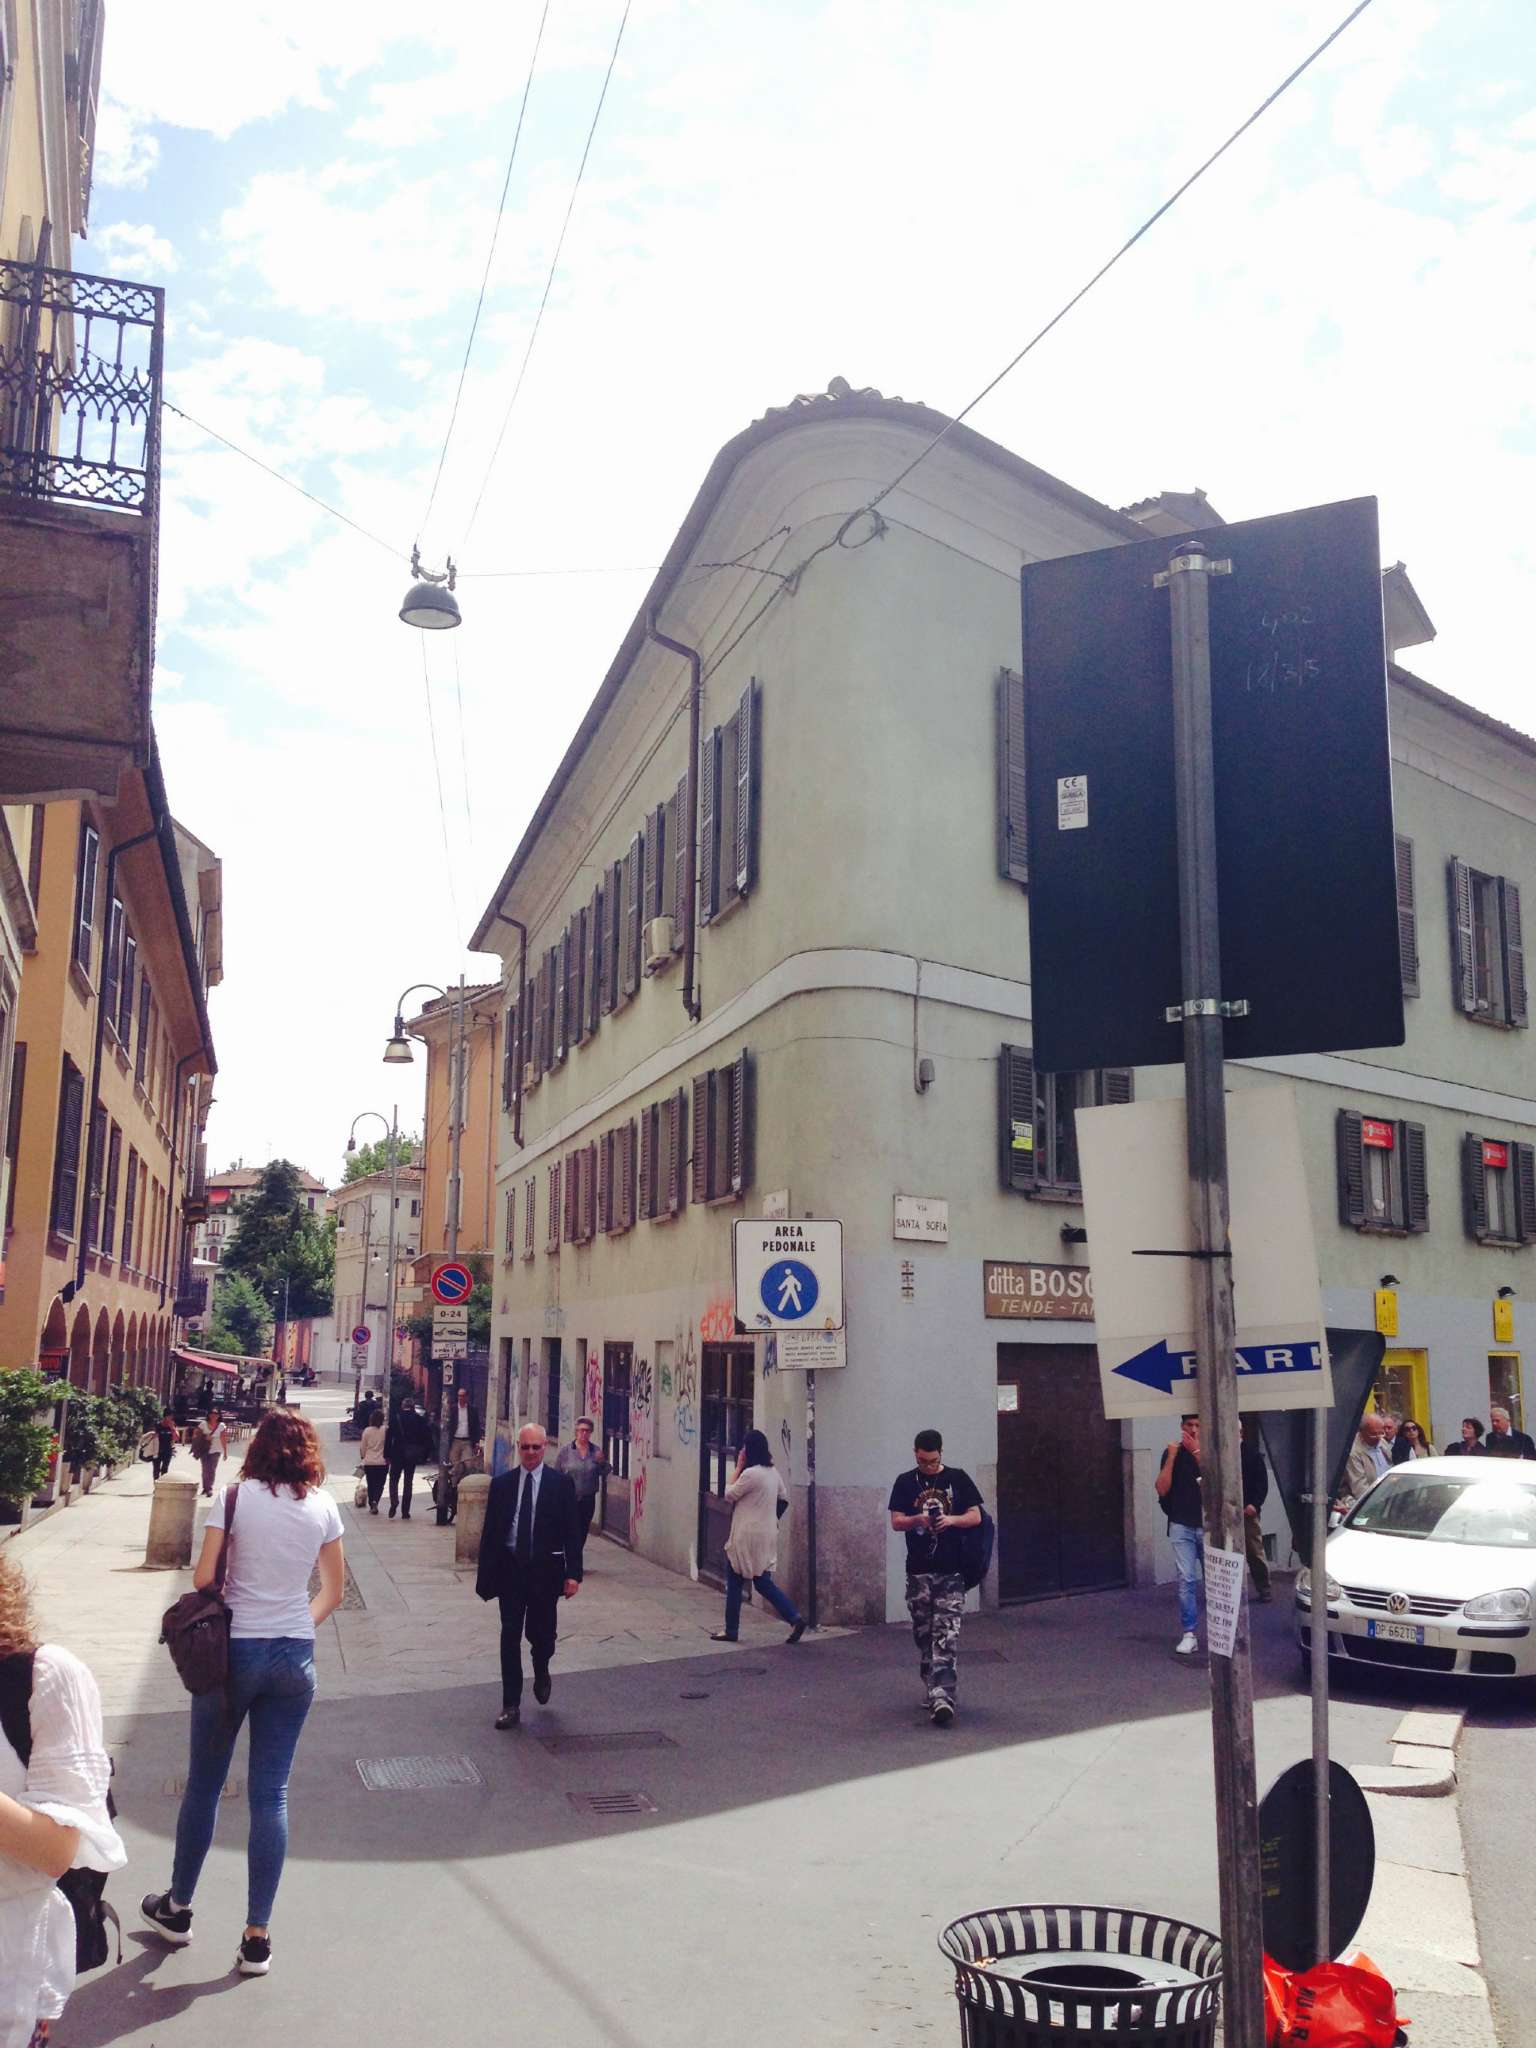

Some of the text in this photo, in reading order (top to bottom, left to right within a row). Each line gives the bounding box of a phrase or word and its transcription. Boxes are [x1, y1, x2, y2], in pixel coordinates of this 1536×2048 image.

[774, 1225, 804, 1238] AREA
[896, 1218, 948, 1232] SANTA SOFIA
[762, 1240, 817, 1253] PEDONALE
[988, 1266, 1025, 1296] ditta
[1000, 1298, 1055, 1315] TENDE
[440, 1310, 462, 1319] 0-24
